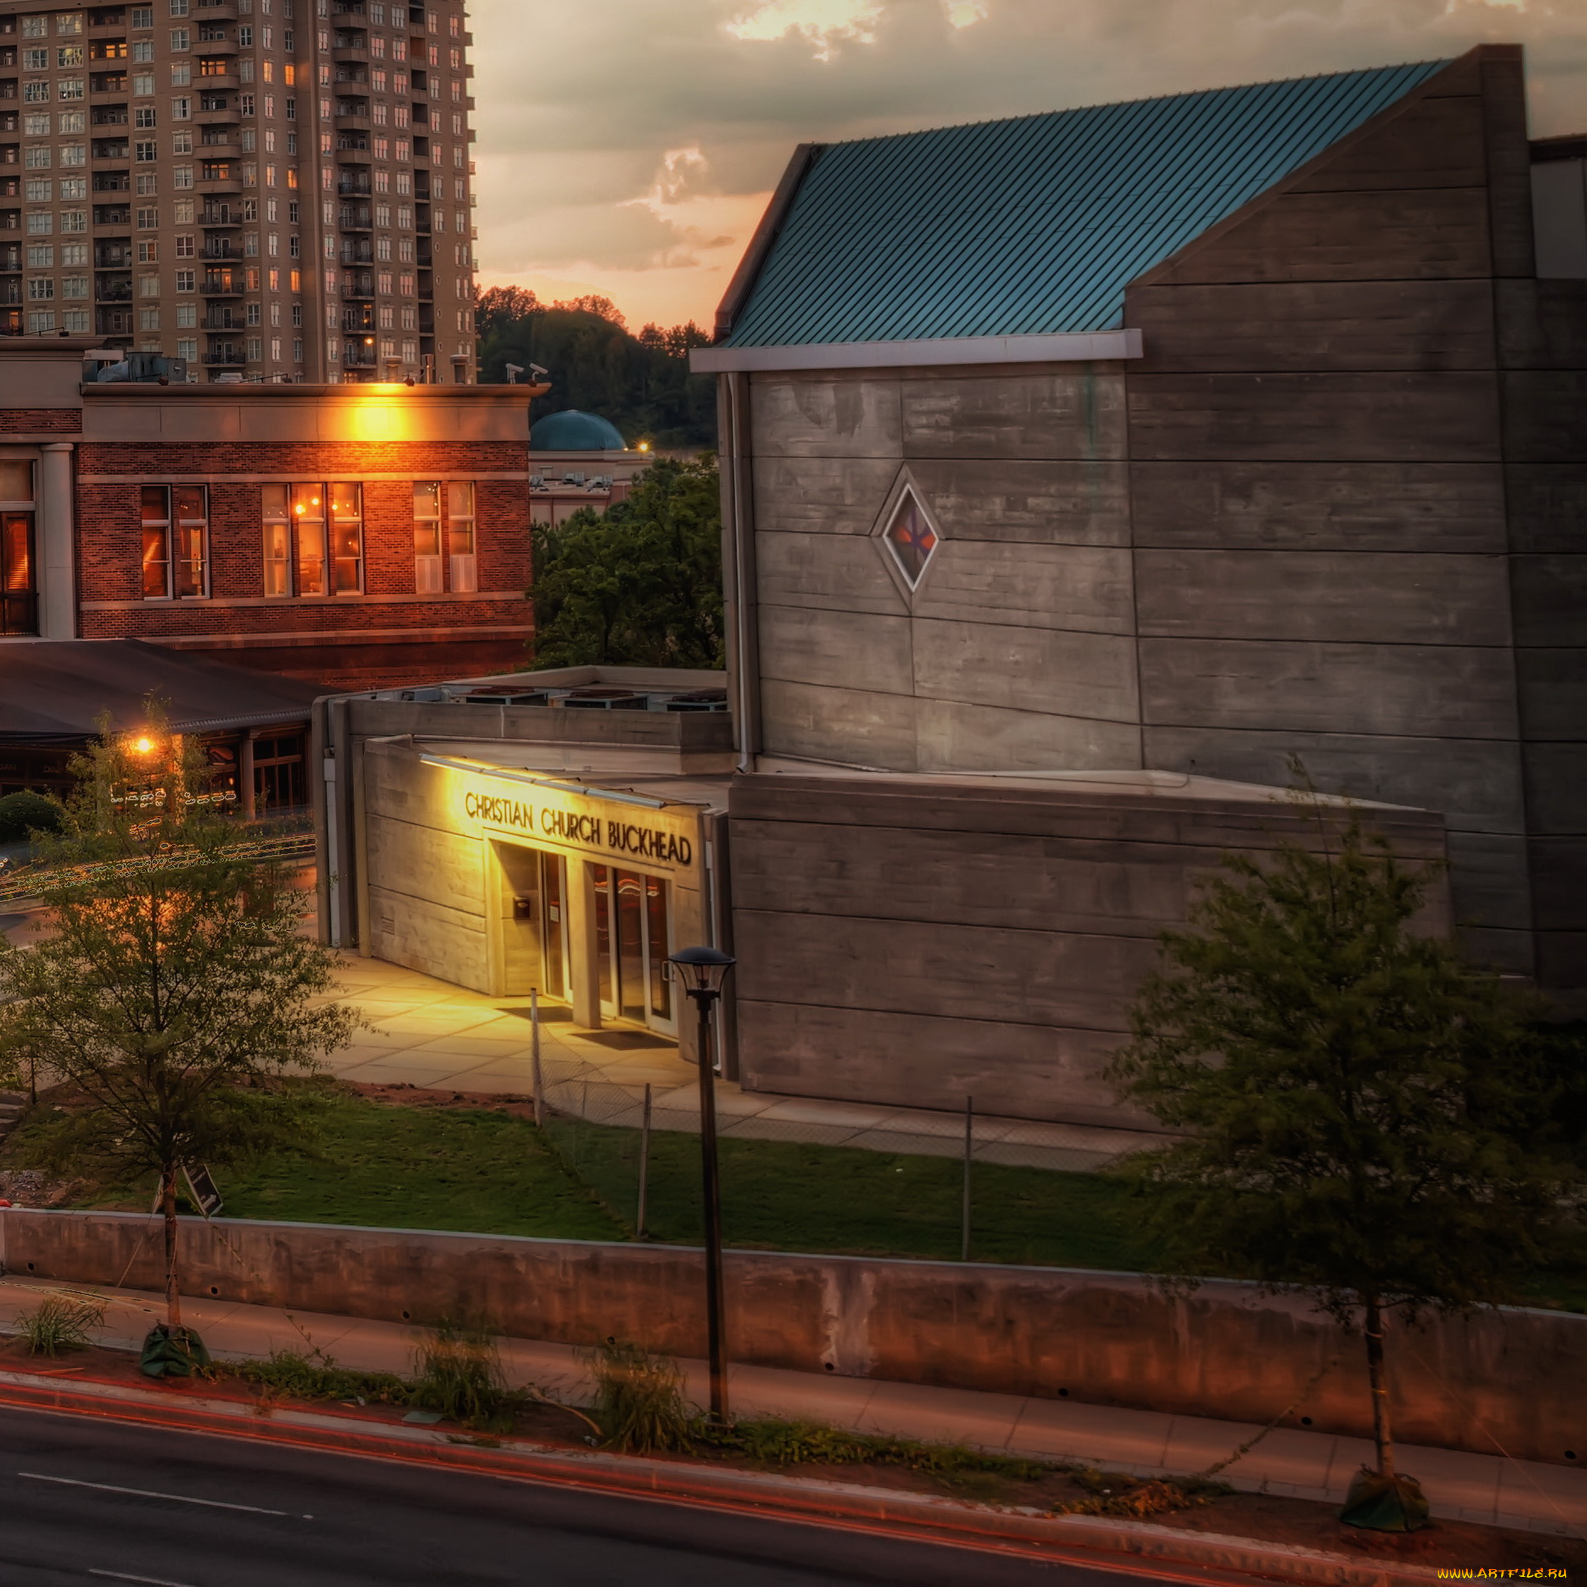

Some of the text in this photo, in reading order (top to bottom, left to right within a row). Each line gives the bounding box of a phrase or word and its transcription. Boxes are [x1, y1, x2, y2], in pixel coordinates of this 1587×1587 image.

[465, 792, 692, 865] CHRISTIAN CHURCH BUCKHEAD
